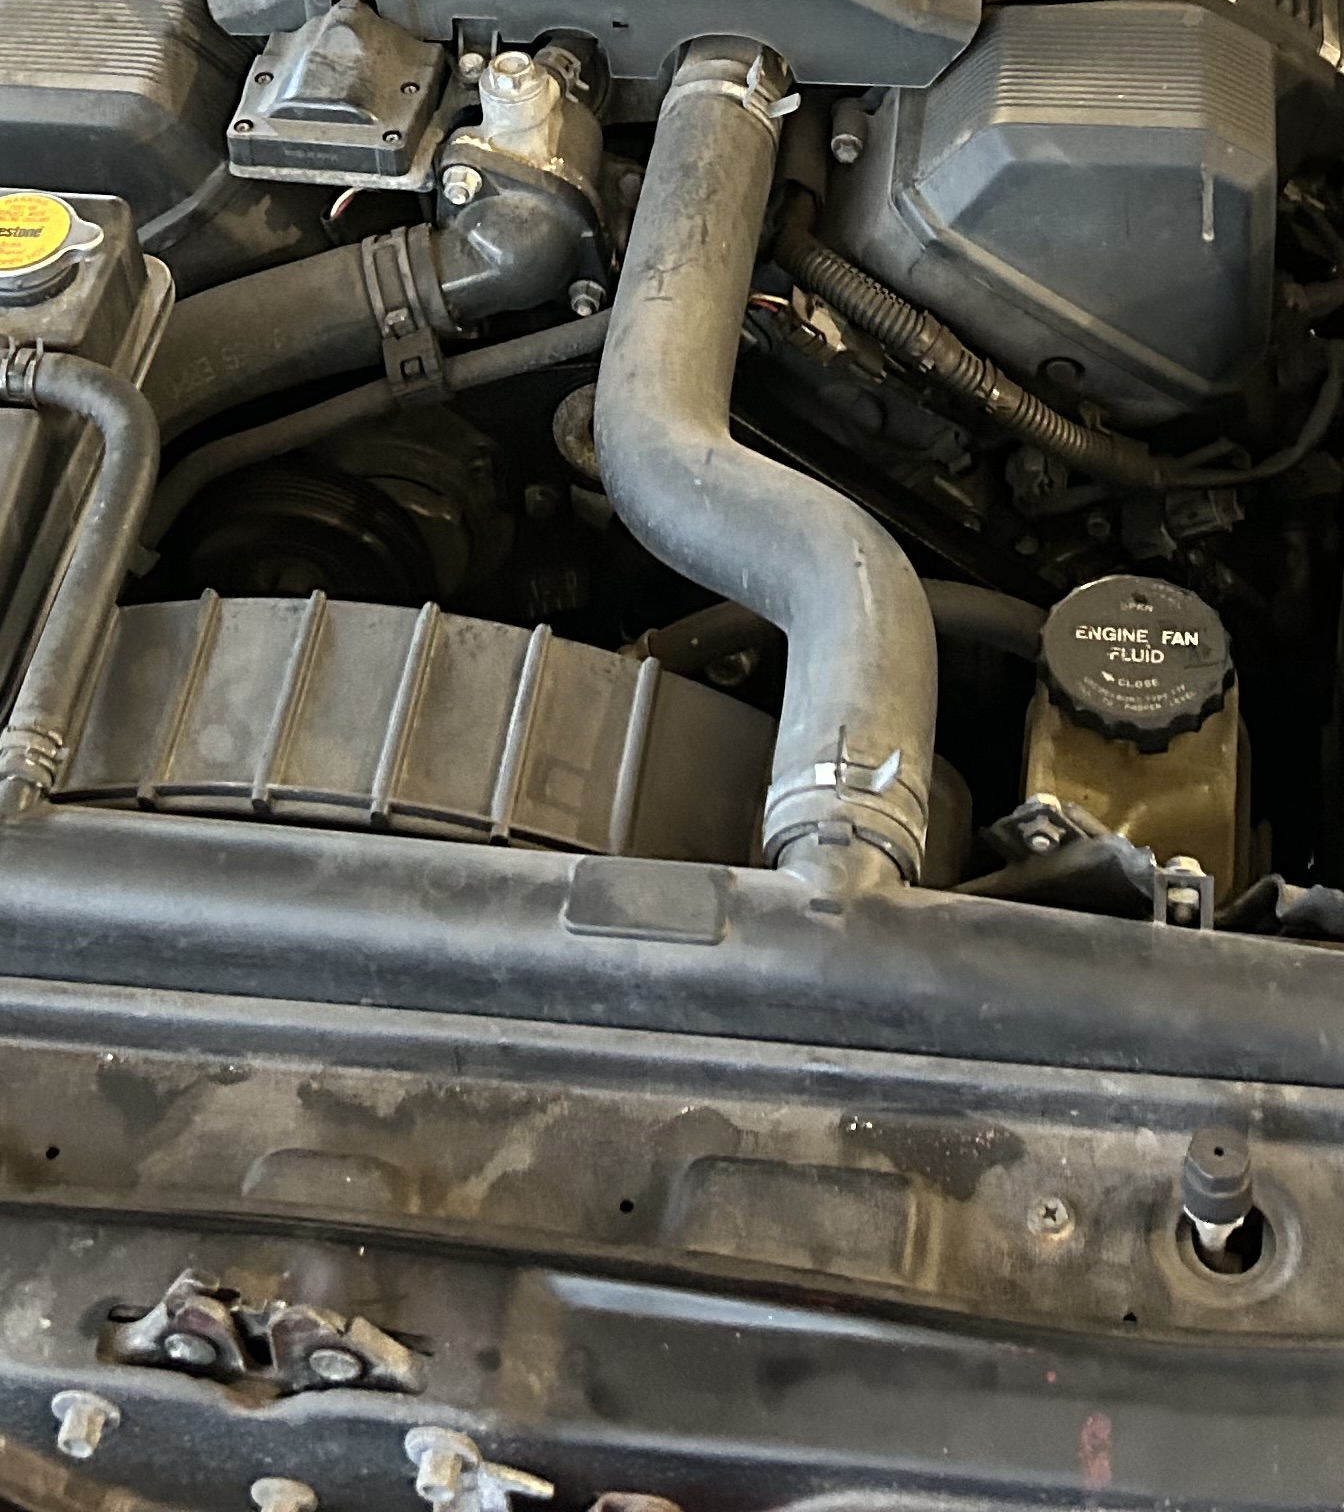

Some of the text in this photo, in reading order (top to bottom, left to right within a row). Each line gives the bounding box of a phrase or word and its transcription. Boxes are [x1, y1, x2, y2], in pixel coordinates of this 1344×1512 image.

[1074, 625, 1199, 646] ENGINE FAN
[1107, 646, 1165, 664] FLUID
[1117, 677, 1160, 688] CLOSE
